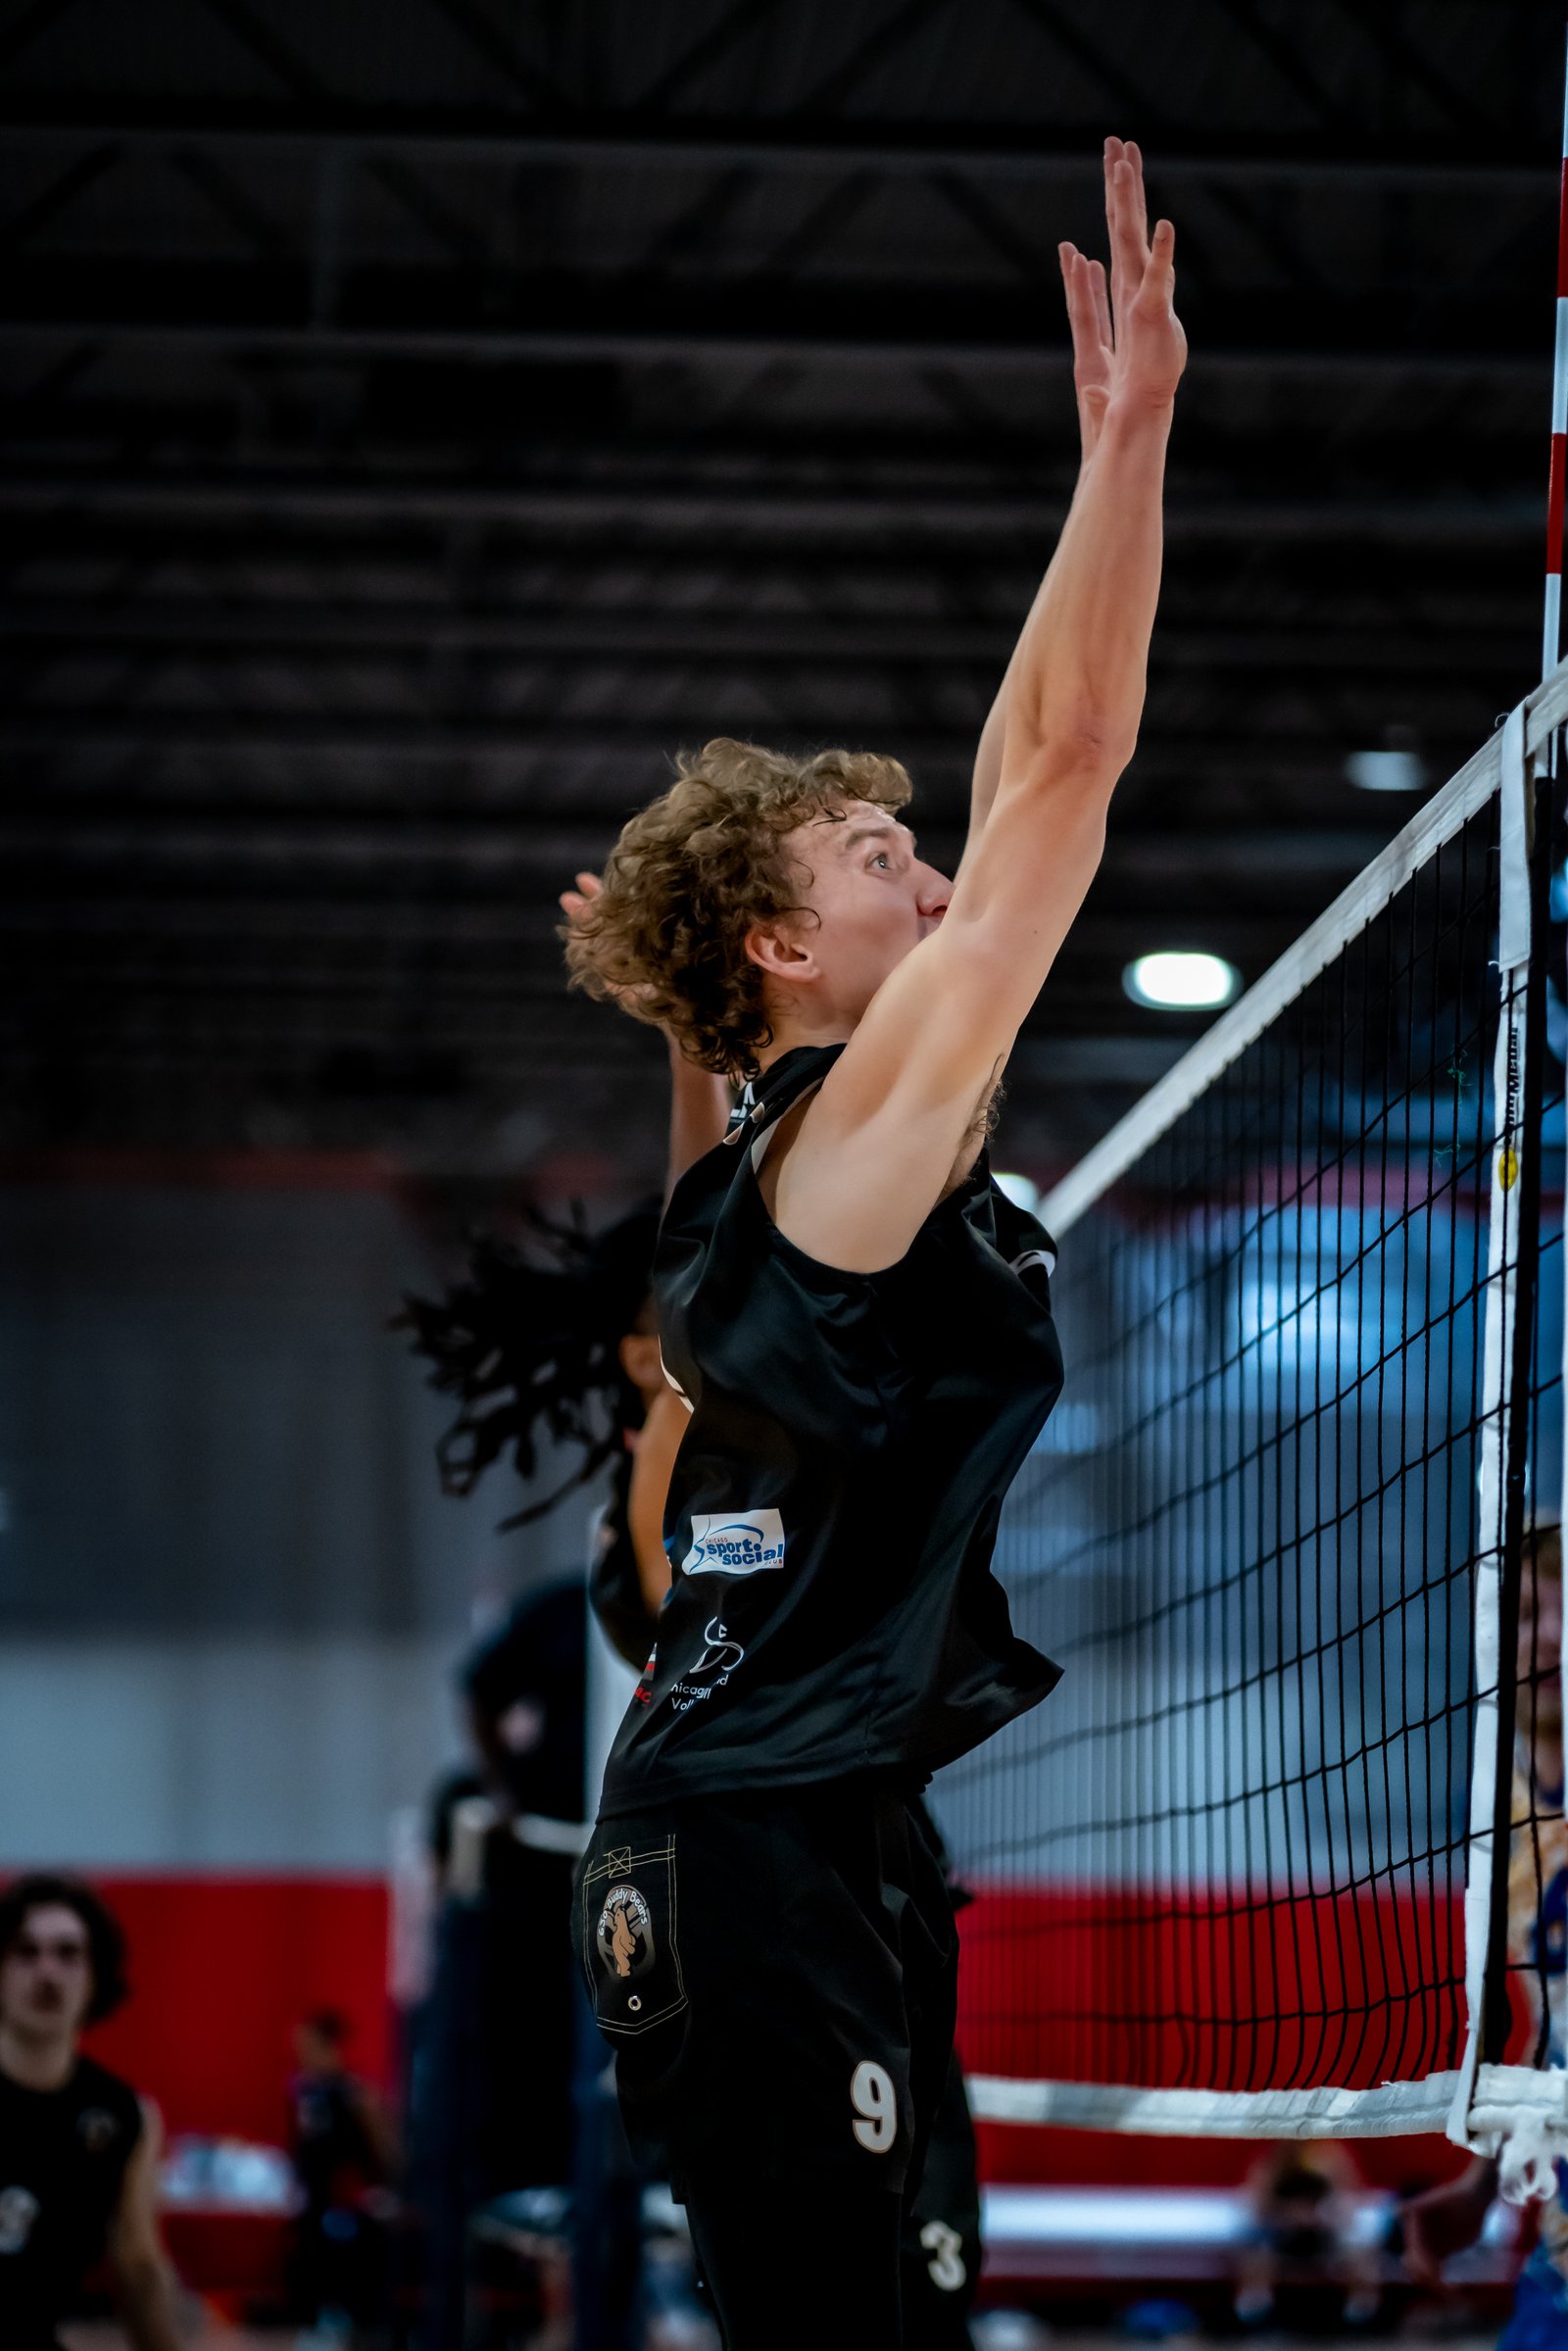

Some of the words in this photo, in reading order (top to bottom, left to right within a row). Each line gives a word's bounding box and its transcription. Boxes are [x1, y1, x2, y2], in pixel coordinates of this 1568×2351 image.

[706, 1539, 753, 1557] sport
[722, 1543, 784, 1565] social
[608, 1887, 628, 1910] Buddy
[629, 1890, 648, 1925] Bears
[850, 2060, 898, 2154] 9
[919, 2220, 967, 2291] 3
